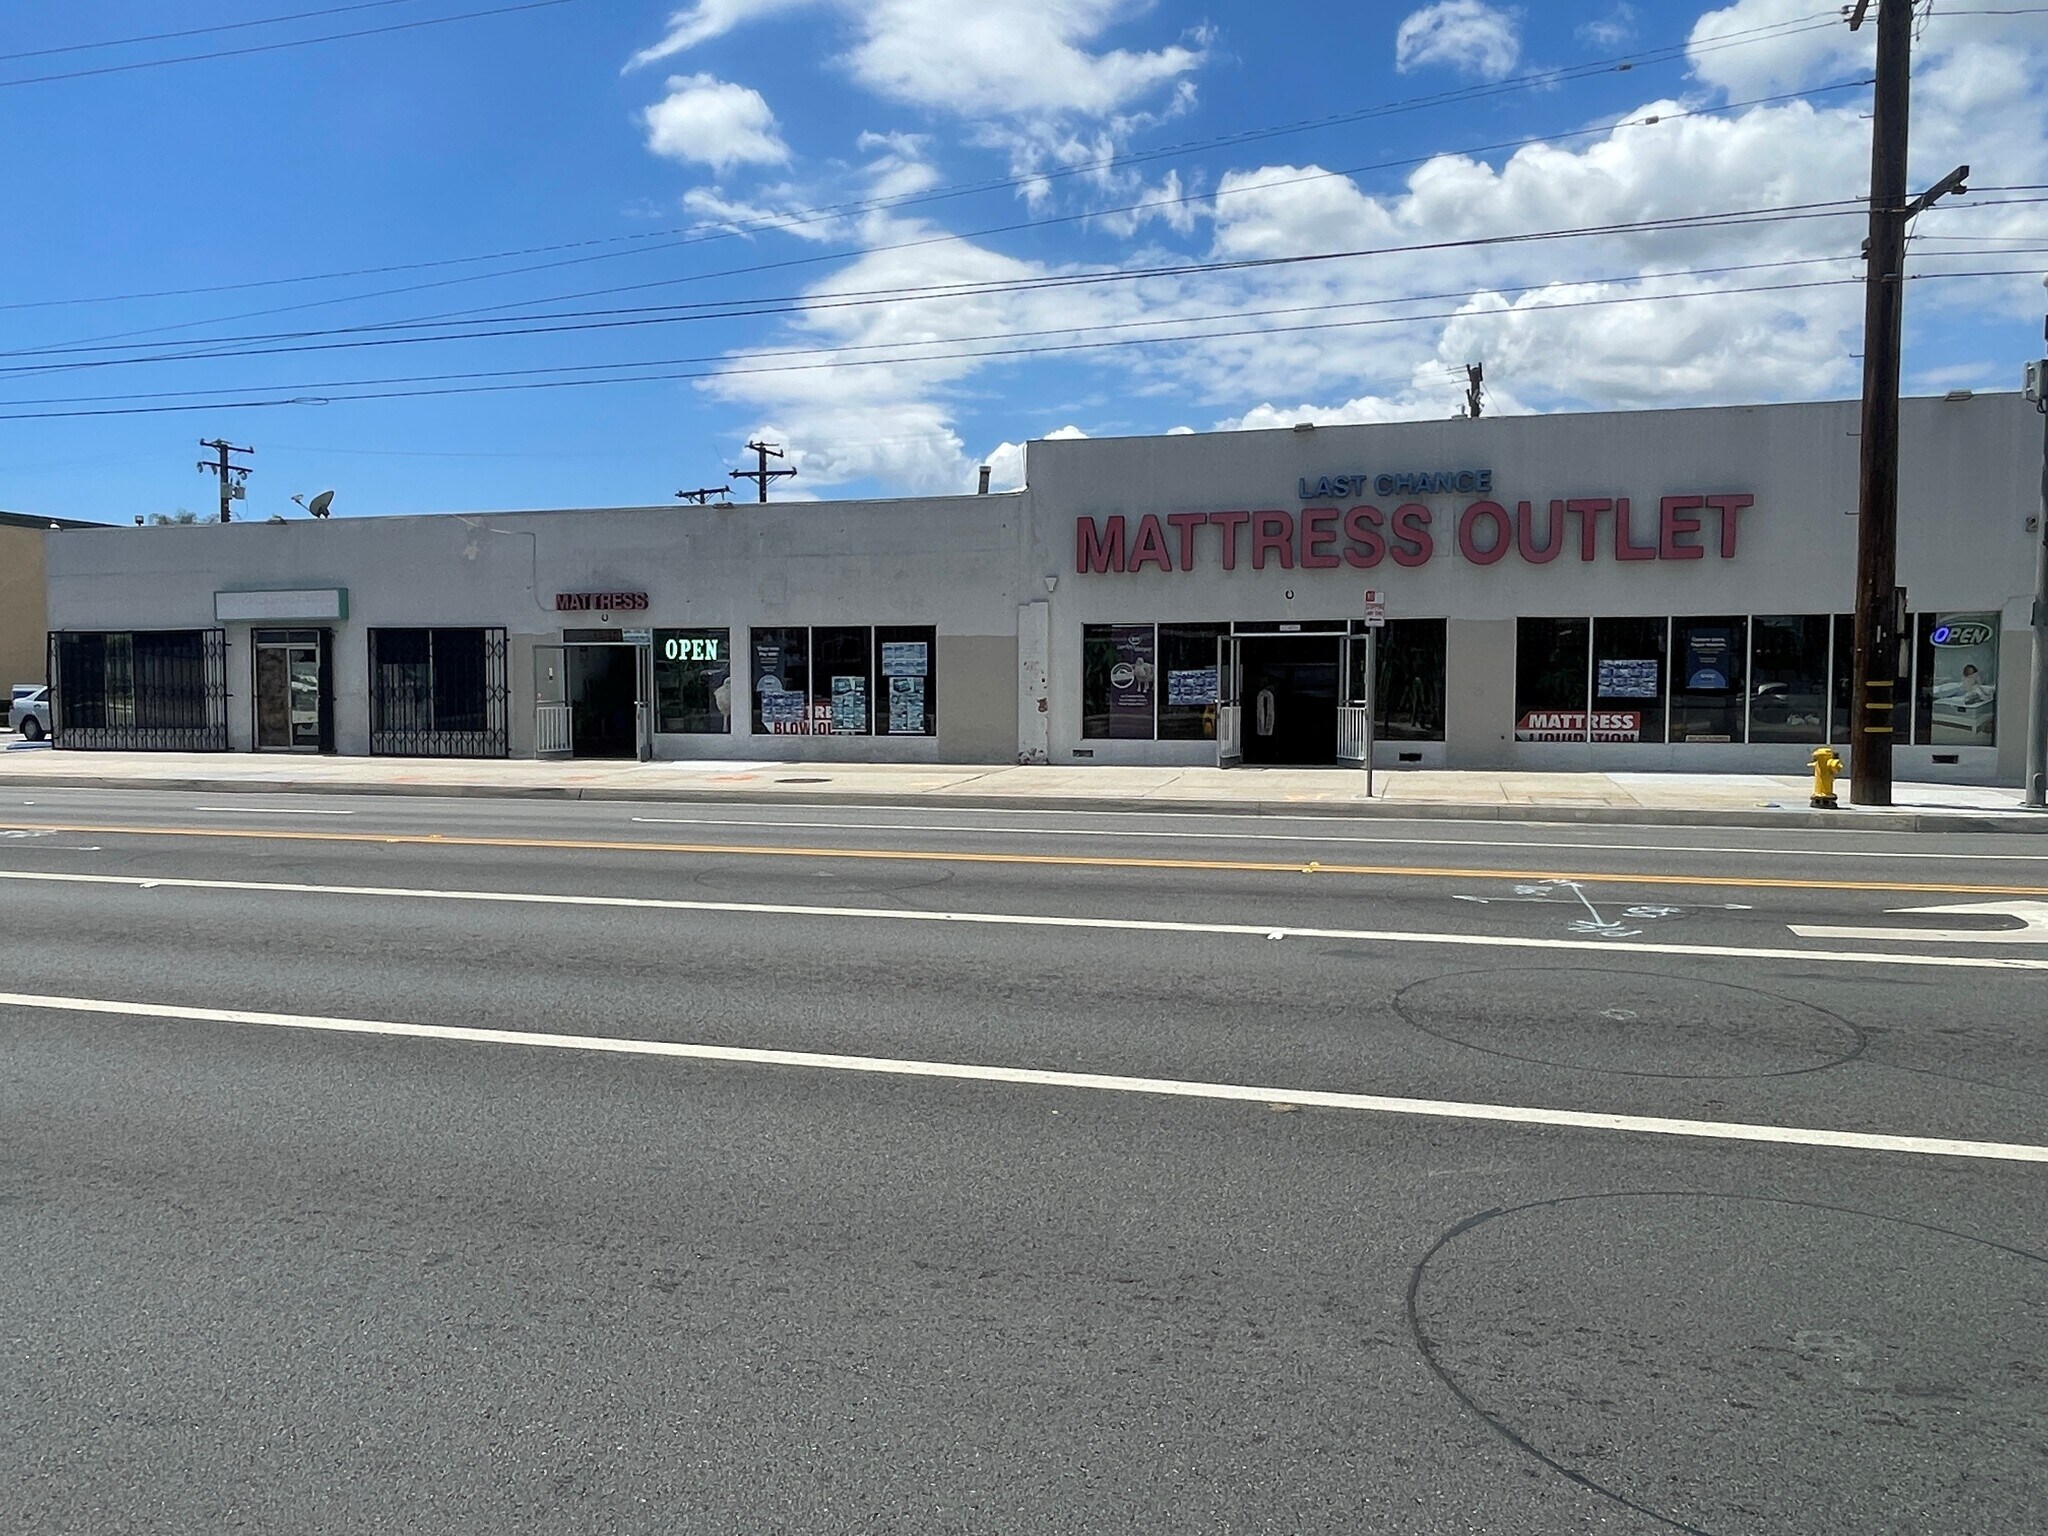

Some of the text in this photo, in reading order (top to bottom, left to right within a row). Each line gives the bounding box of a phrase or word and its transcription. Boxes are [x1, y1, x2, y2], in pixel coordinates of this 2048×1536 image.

[1298, 469, 1493, 499] LAST CHANCE
[1076, 493, 1755, 574] MATTRESS OUTLET
[556, 592, 649, 611] MATTRESS
[1934, 625, 1987, 645] OPEN
[665, 638, 719, 661] OPEN
[1528, 713, 1634, 729] MATTRESS
